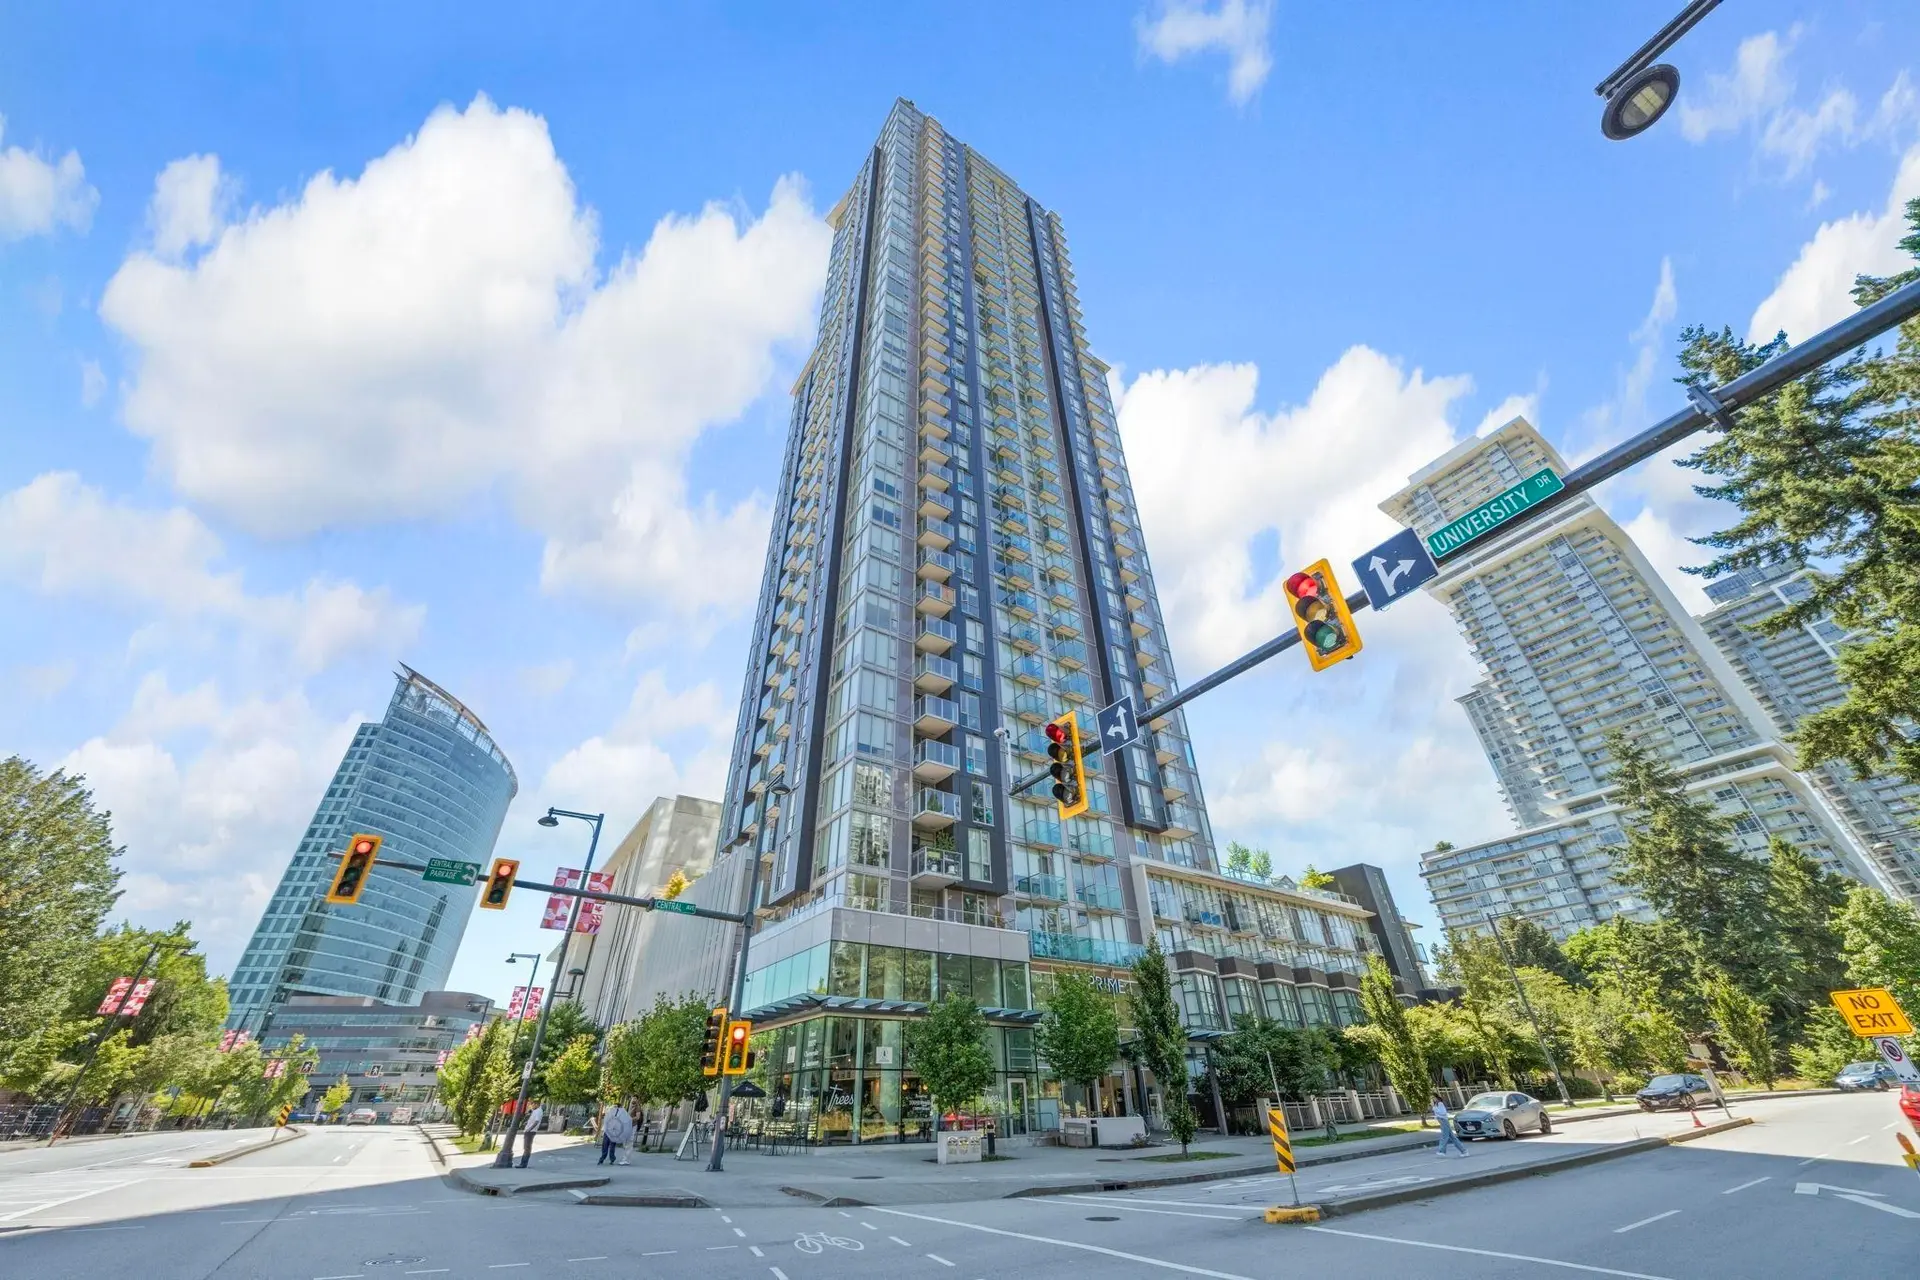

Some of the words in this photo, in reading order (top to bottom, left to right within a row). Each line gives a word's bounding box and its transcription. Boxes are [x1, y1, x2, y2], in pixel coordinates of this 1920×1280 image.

[1433, 486, 1530, 552] UNIVERSITY
[1535, 474, 1552, 488] DR
[430, 859, 453, 868] CENTRAL
[453, 862, 464, 870] AVE
[429, 869, 457, 879] PARKADE
[656, 900, 682, 912] CENTRAL
[1848, 995, 1880, 1009] NO
[1854, 1012, 1897, 1028] EXIT
[827, 1084, 854, 1112] Trees
